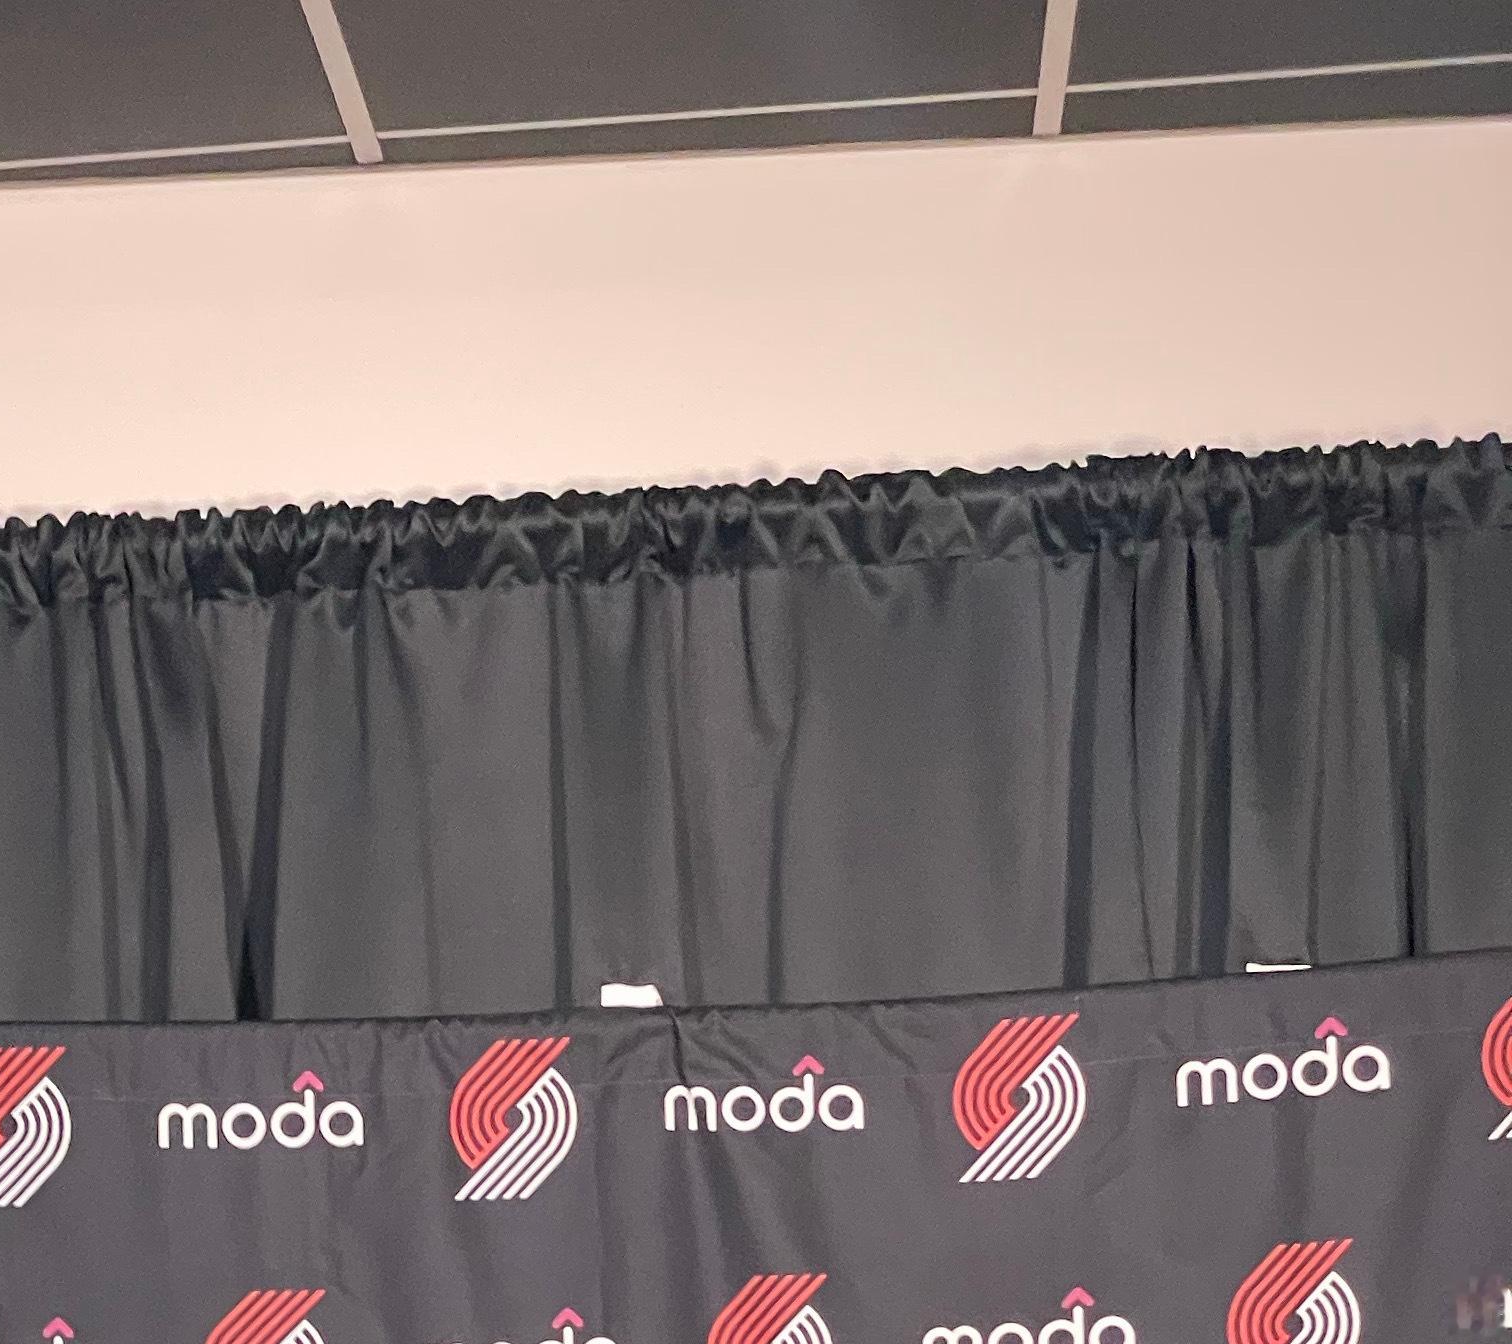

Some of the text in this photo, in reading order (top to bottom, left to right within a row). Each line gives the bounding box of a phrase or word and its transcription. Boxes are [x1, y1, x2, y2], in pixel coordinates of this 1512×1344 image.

[664, 1055, 865, 1132] moda
[1176, 1017, 1392, 1107] moda
[158, 1071, 364, 1150] moda
